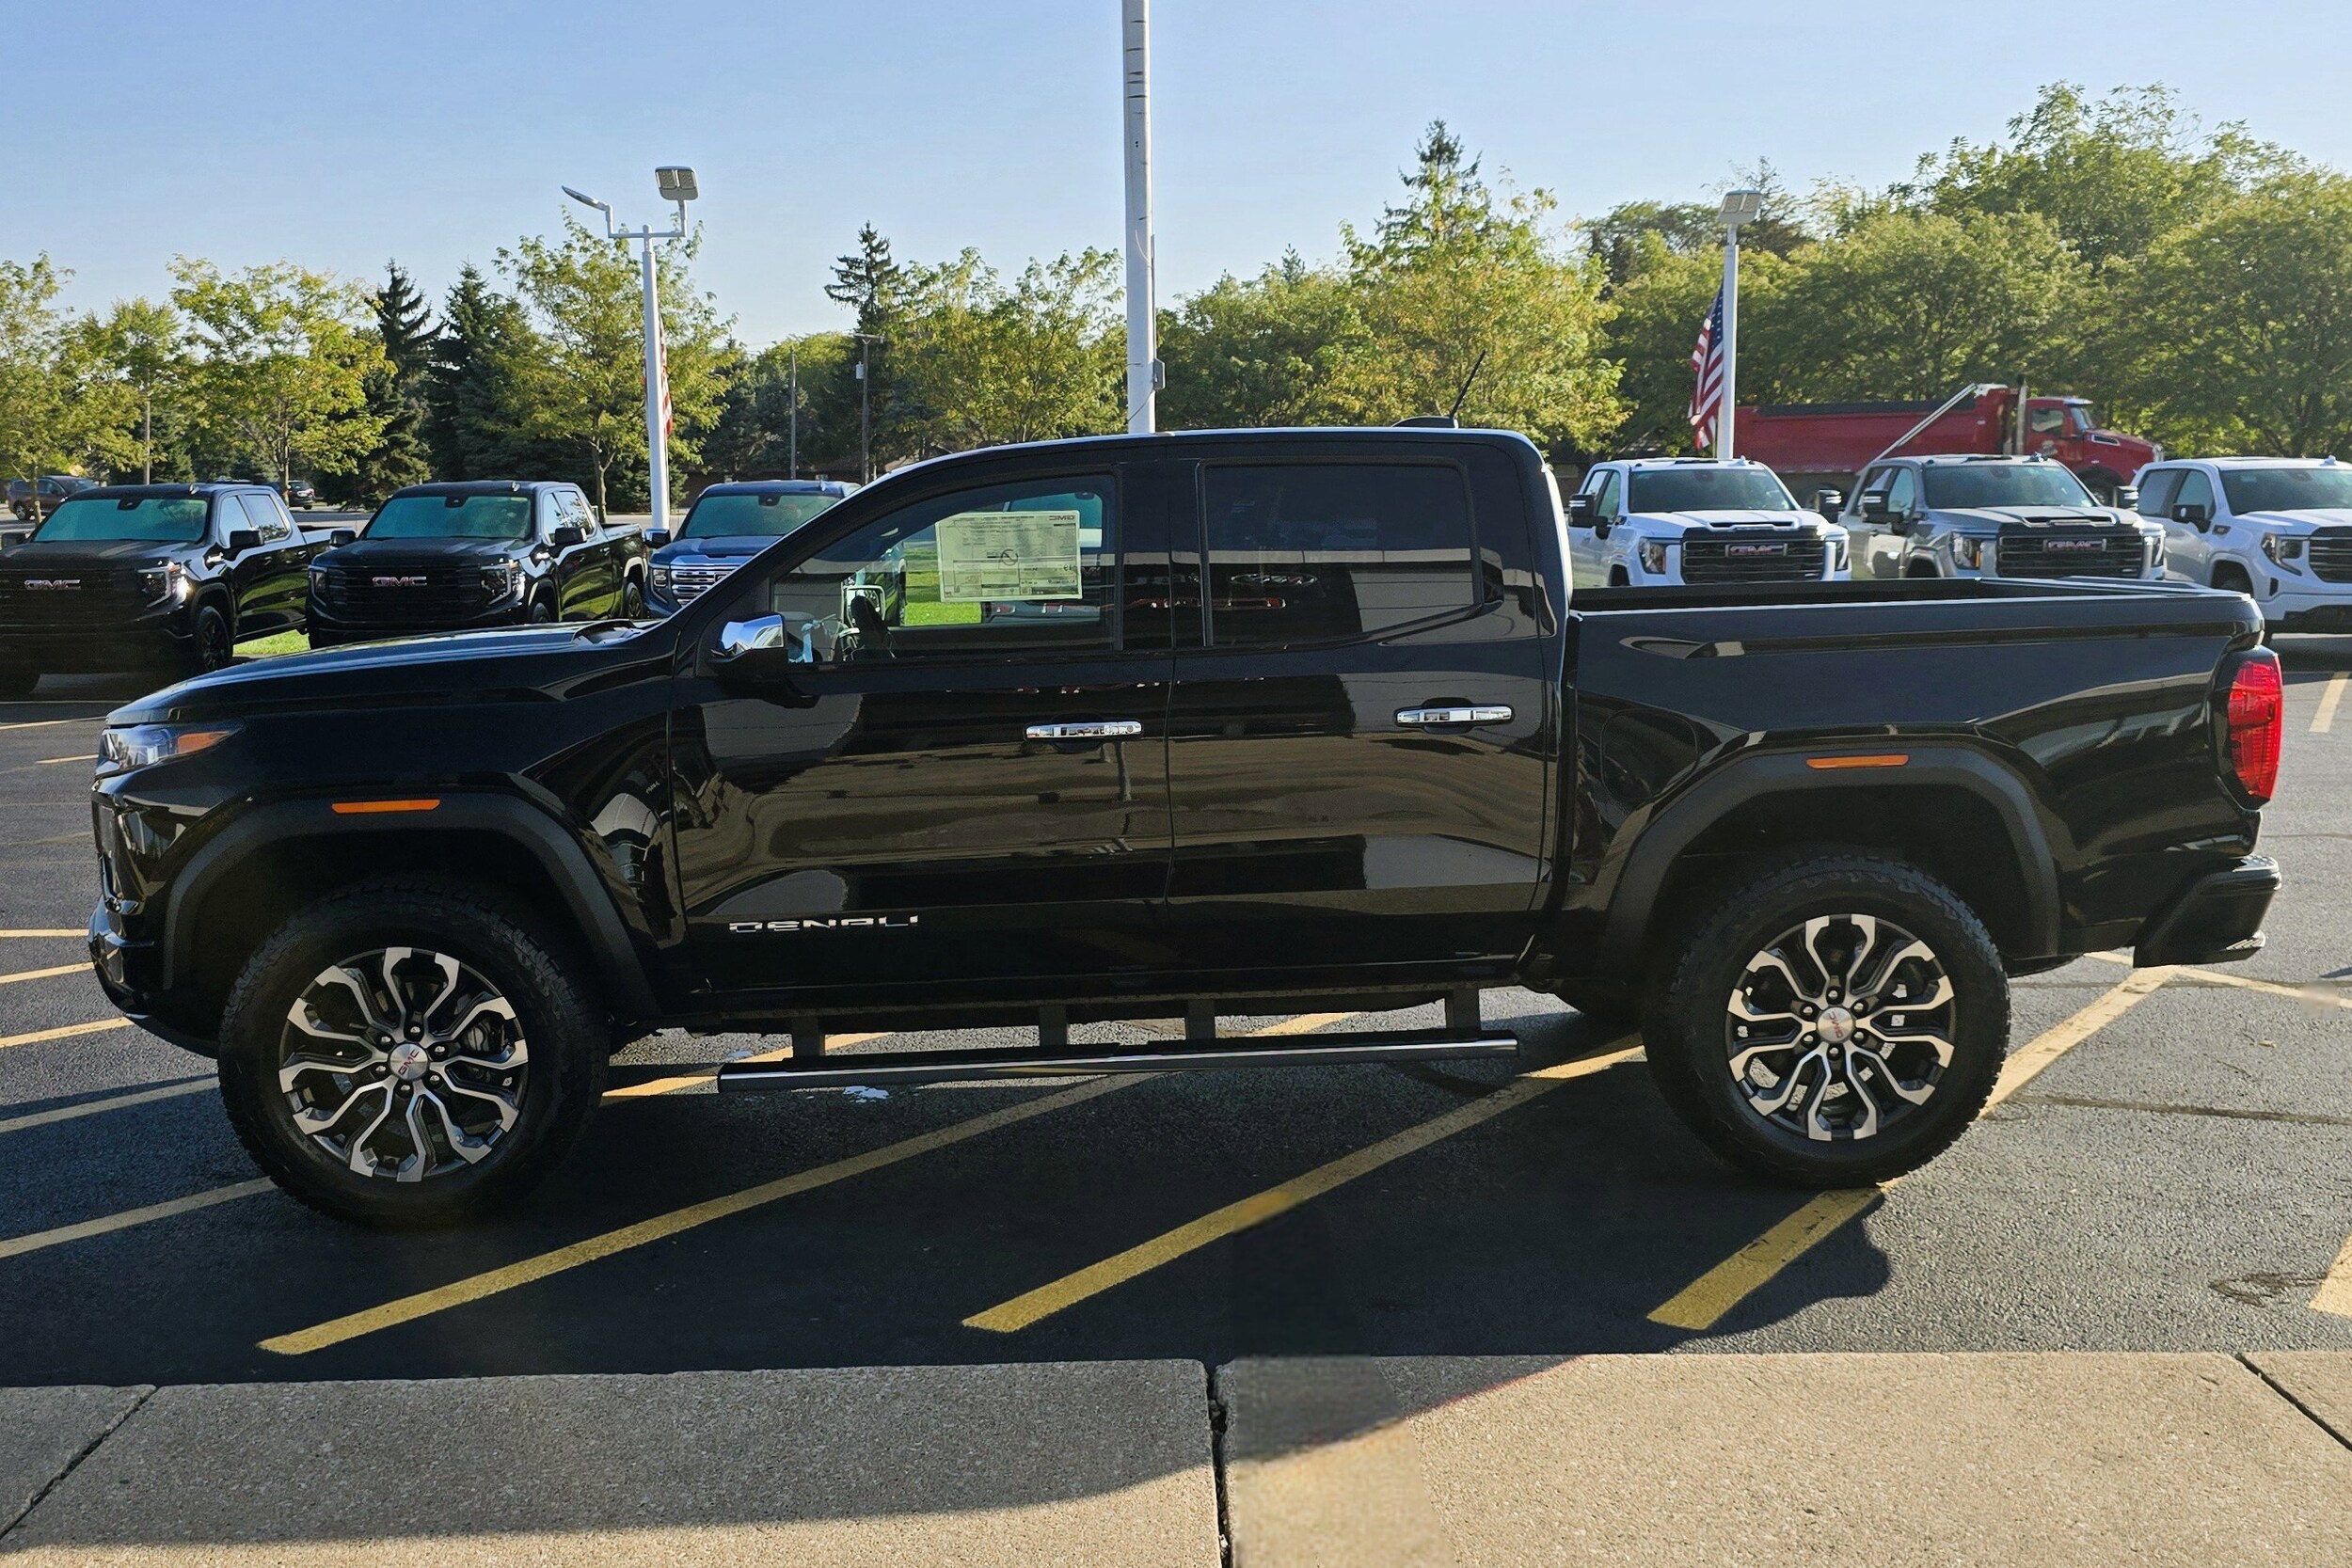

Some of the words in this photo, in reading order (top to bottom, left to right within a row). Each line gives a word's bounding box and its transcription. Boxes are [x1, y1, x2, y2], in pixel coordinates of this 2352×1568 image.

[1730, 545, 1784, 555] GMC
[2048, 540, 2103, 551] GMC
[24, 579, 81, 590] GMC
[372, 577, 427, 587] GMC
[729, 915, 918, 932] DENALI
[1828, 1010, 1844, 1038] GMC
[398, 1049, 420, 1075] GMC
